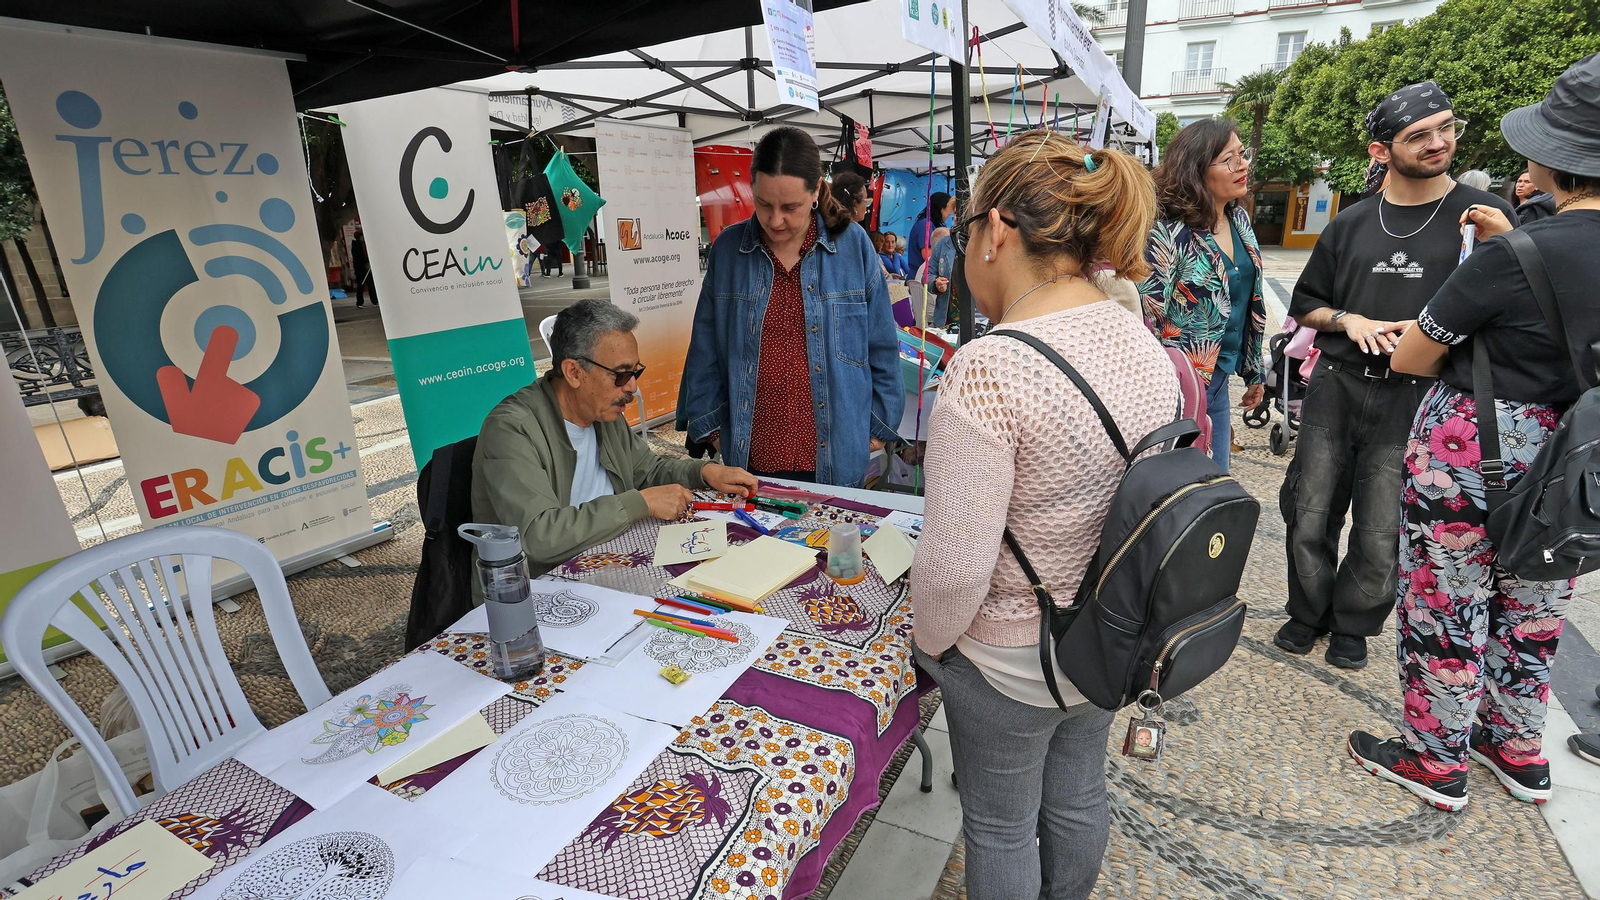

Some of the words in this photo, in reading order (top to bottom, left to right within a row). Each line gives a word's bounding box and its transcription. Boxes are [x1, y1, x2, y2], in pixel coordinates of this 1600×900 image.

[633, 253, 681, 265] www.acoge.org
[410, 283, 449, 294] Convivencia
[456, 278, 485, 289] inclusión
[486, 277, 504, 287] social
[640, 283, 660, 295] persona
[661, 281, 674, 290] tiene
[675, 278, 694, 288] derecho
[637, 293, 656, 304] circular
[418, 355, 526, 386] www.ceain.acoge.org
[182, 515, 206, 527] LOCAL
[218, 497, 269, 516] INTERVENCIÓN
[280, 486, 301, 499] ZONAS
[302, 471, 355, 491] DESFAVORECIDAS
[227, 512, 255, 524] Andaluza
[257, 507, 271, 516] para
[282, 495, 307, 508] Cohesión
[315, 487, 339, 498] Inclusión
[340, 480, 356, 490] Social
